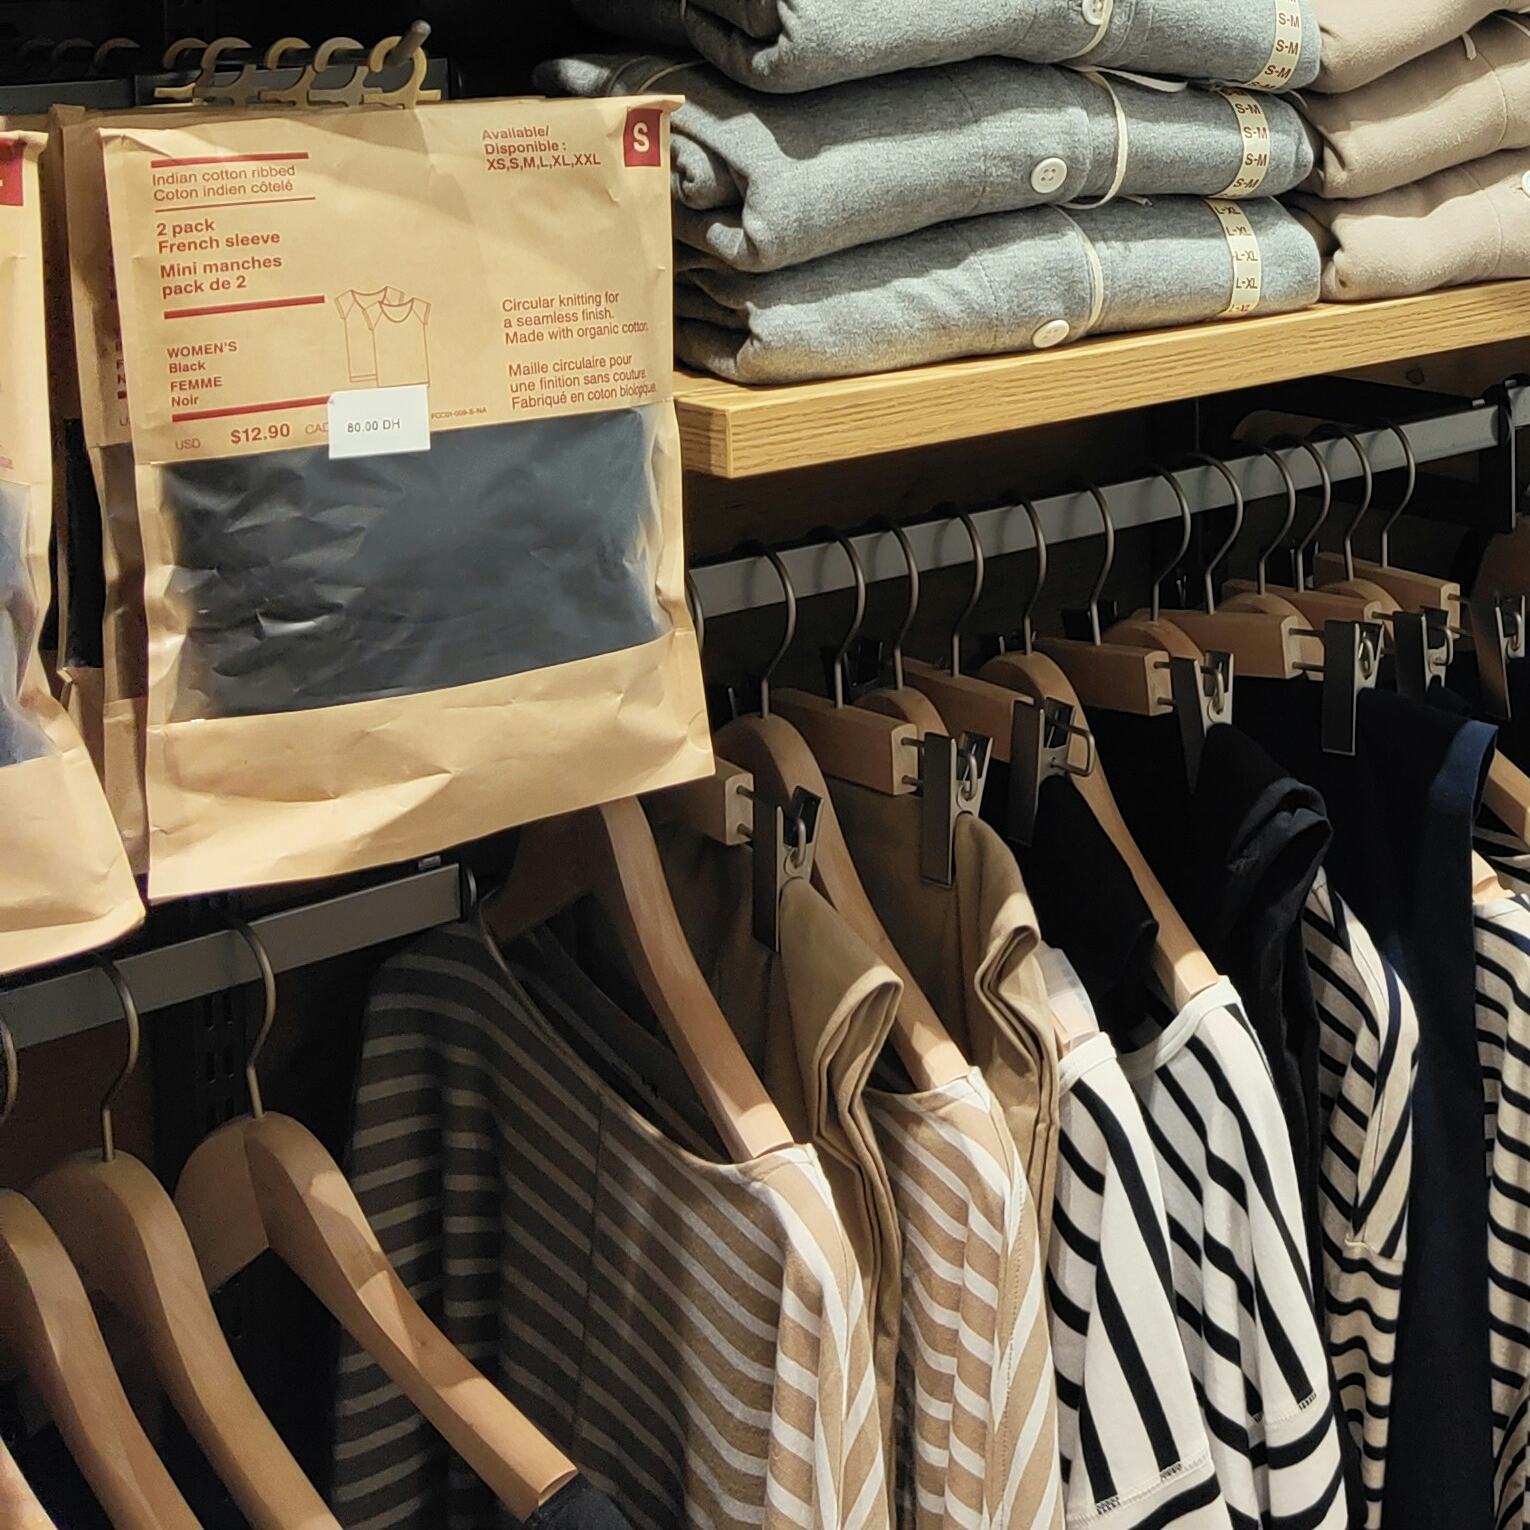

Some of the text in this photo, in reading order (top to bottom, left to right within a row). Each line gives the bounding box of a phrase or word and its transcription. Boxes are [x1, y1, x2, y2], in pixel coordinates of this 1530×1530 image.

[1278, 12, 1299, 28] S-M
[1276, 39, 1298, 55] S-M
[1264, 64, 1292, 79] S-M
[1235, 103, 1261, 114] S-M
[482, 125, 549, 140] Available/
[633, 122, 649, 152] S
[1243, 127, 1267, 139] S-M
[487, 154, 601, 172] XS,S,M,L,XL,XXL
[1245, 153, 1267, 166] S-M
[152, 166, 295, 186] Indian cotton ribbed
[1233, 178, 1259, 188] S-M
[154, 180, 293, 202] Coton indien côtelé
[1215, 206, 1241, 214] L-XL
[156, 218, 215, 237] 2 pack
[1226, 227, 1252, 236] L-XL
[158, 233, 280, 253] French sleeve
[1235, 250, 1258, 261] L-XL
[161, 256, 282, 278] Mini manches
[162, 275, 247, 299] pack de 2
[1236, 278, 1258, 289] L-XL
[502, 291, 619, 312] Circular knitting for
[504, 308, 614, 328] a seamless finish.
[505, 330, 544, 344] Made
[548, 327, 573, 340] with
[577, 323, 619, 339] organic
[167, 341, 237, 358] WOMEN'S
[169, 360, 206, 373] Black
[509, 354, 632, 377] Maille circulaire pour
[170, 376, 222, 392] FEMME
[510, 381, 535, 393] une
[540, 375, 580, 390] finition
[584, 372, 610, 385] sans
[172, 395, 199, 407] Noir
[511, 393, 567, 410] Fabriqué
[571, 392, 584, 403] en
[588, 387, 617, 400] coton
[383, 419, 400, 429] DH
[175, 438, 200, 450] USD
[231, 424, 290, 444] $12.90
